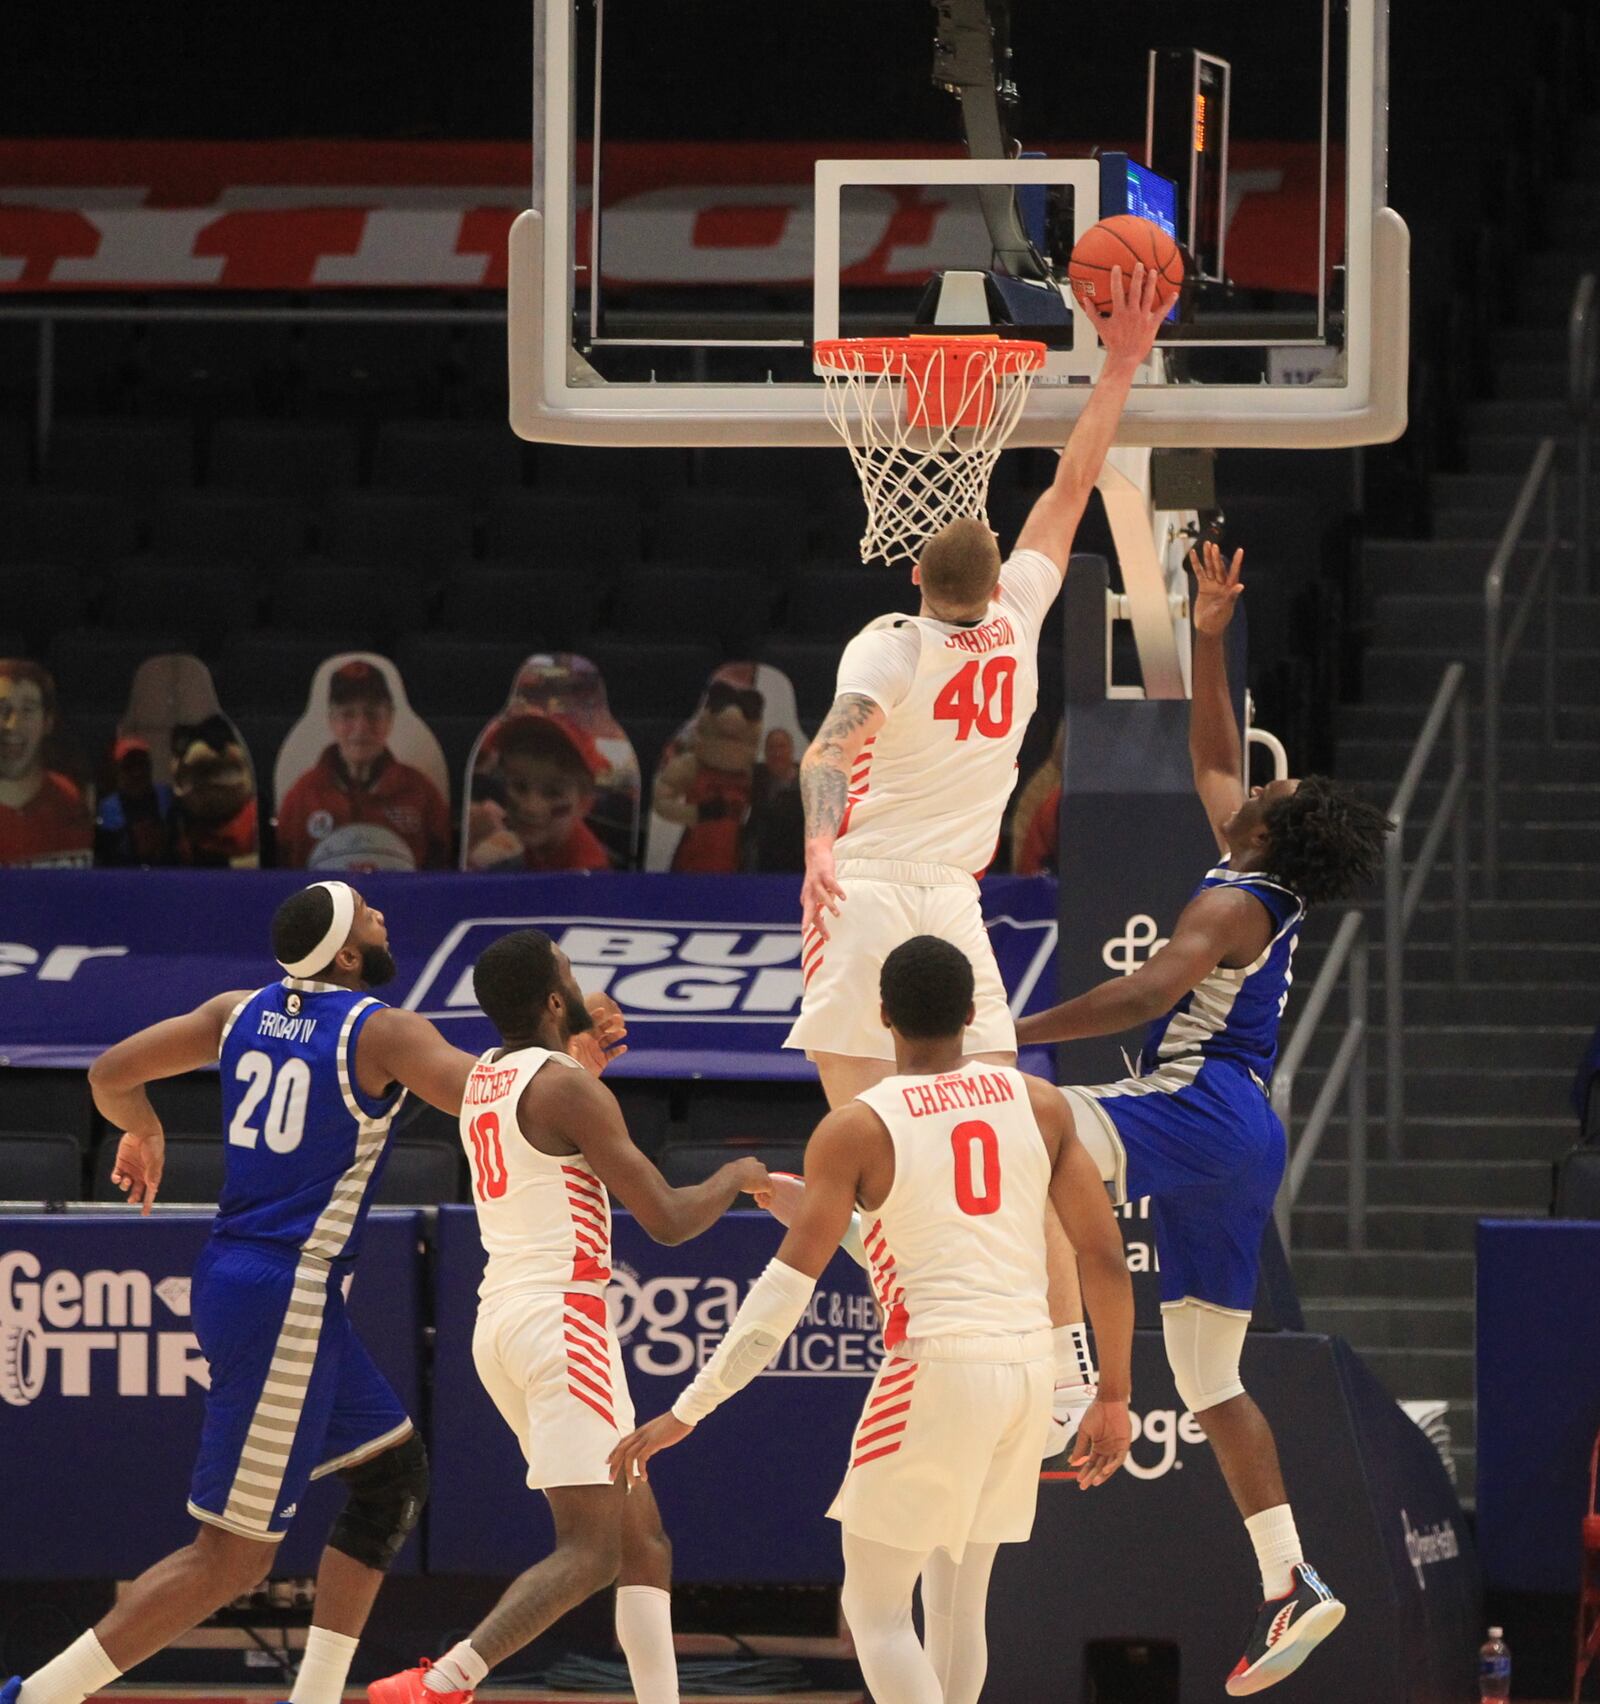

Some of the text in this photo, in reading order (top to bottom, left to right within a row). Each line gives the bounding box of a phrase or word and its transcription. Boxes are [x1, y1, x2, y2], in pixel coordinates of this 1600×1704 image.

[933, 656, 1017, 741] 40
[257, 1010, 317, 1043] FRIDAY IV
[229, 1050, 311, 1154] 20
[902, 1072, 1015, 1117] CHATMAN
[469, 1111, 508, 1202] 10
[951, 1120, 1001, 1216] 0
[0, 1251, 152, 1328] Gem
[828, 1291, 845, 1327] &
